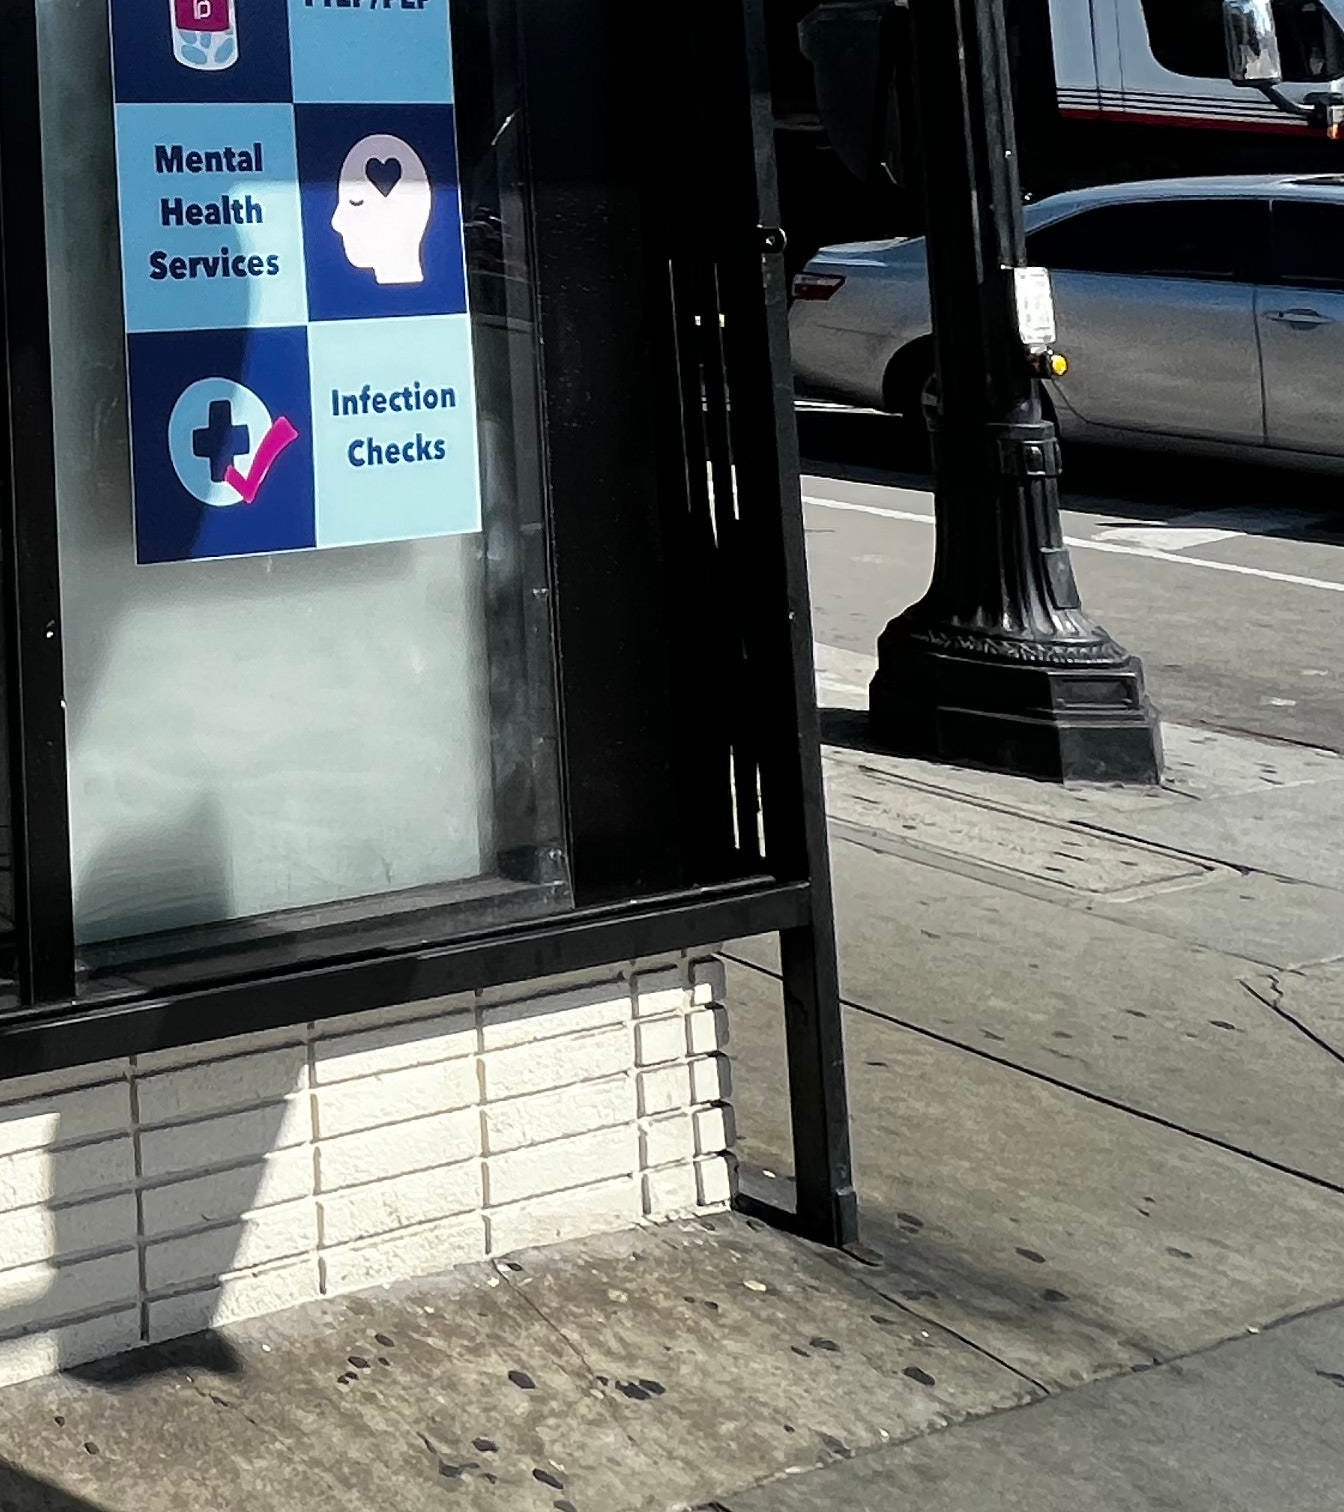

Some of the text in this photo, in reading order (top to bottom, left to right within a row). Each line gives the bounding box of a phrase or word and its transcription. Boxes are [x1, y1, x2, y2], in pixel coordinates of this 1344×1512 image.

[155, 143, 263, 173] Mental
[160, 195, 263, 226] Health
[149, 247, 279, 280] Services
[332, 382, 456, 417] Infection
[348, 434, 446, 467] Checks
